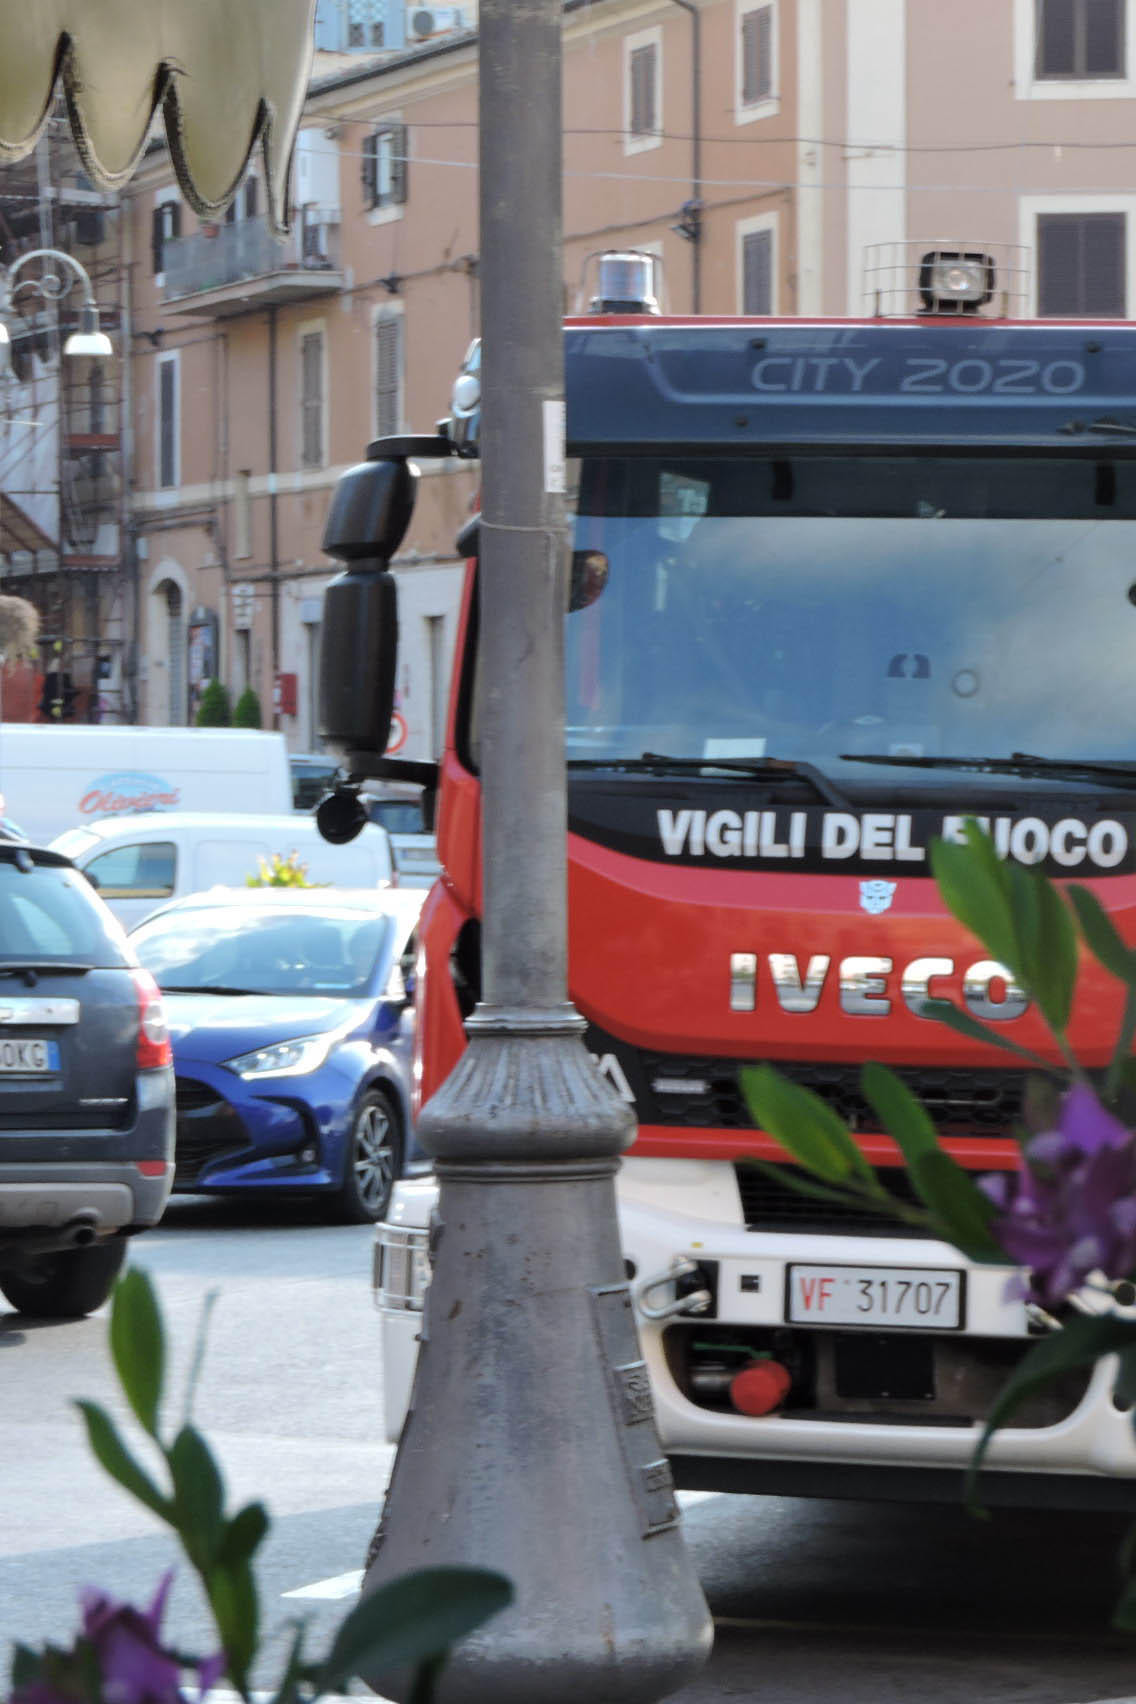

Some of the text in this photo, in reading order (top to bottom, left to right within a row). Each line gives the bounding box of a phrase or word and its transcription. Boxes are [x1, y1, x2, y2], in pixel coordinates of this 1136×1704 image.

[750, 357, 1086, 394] CITY 2020
[657, 809, 807, 858] VIGILI
[822, 813, 925, 861] DEL
[729, 952, 1029, 1021] IVECO
[799, 1277, 951, 1315] VF 31707
